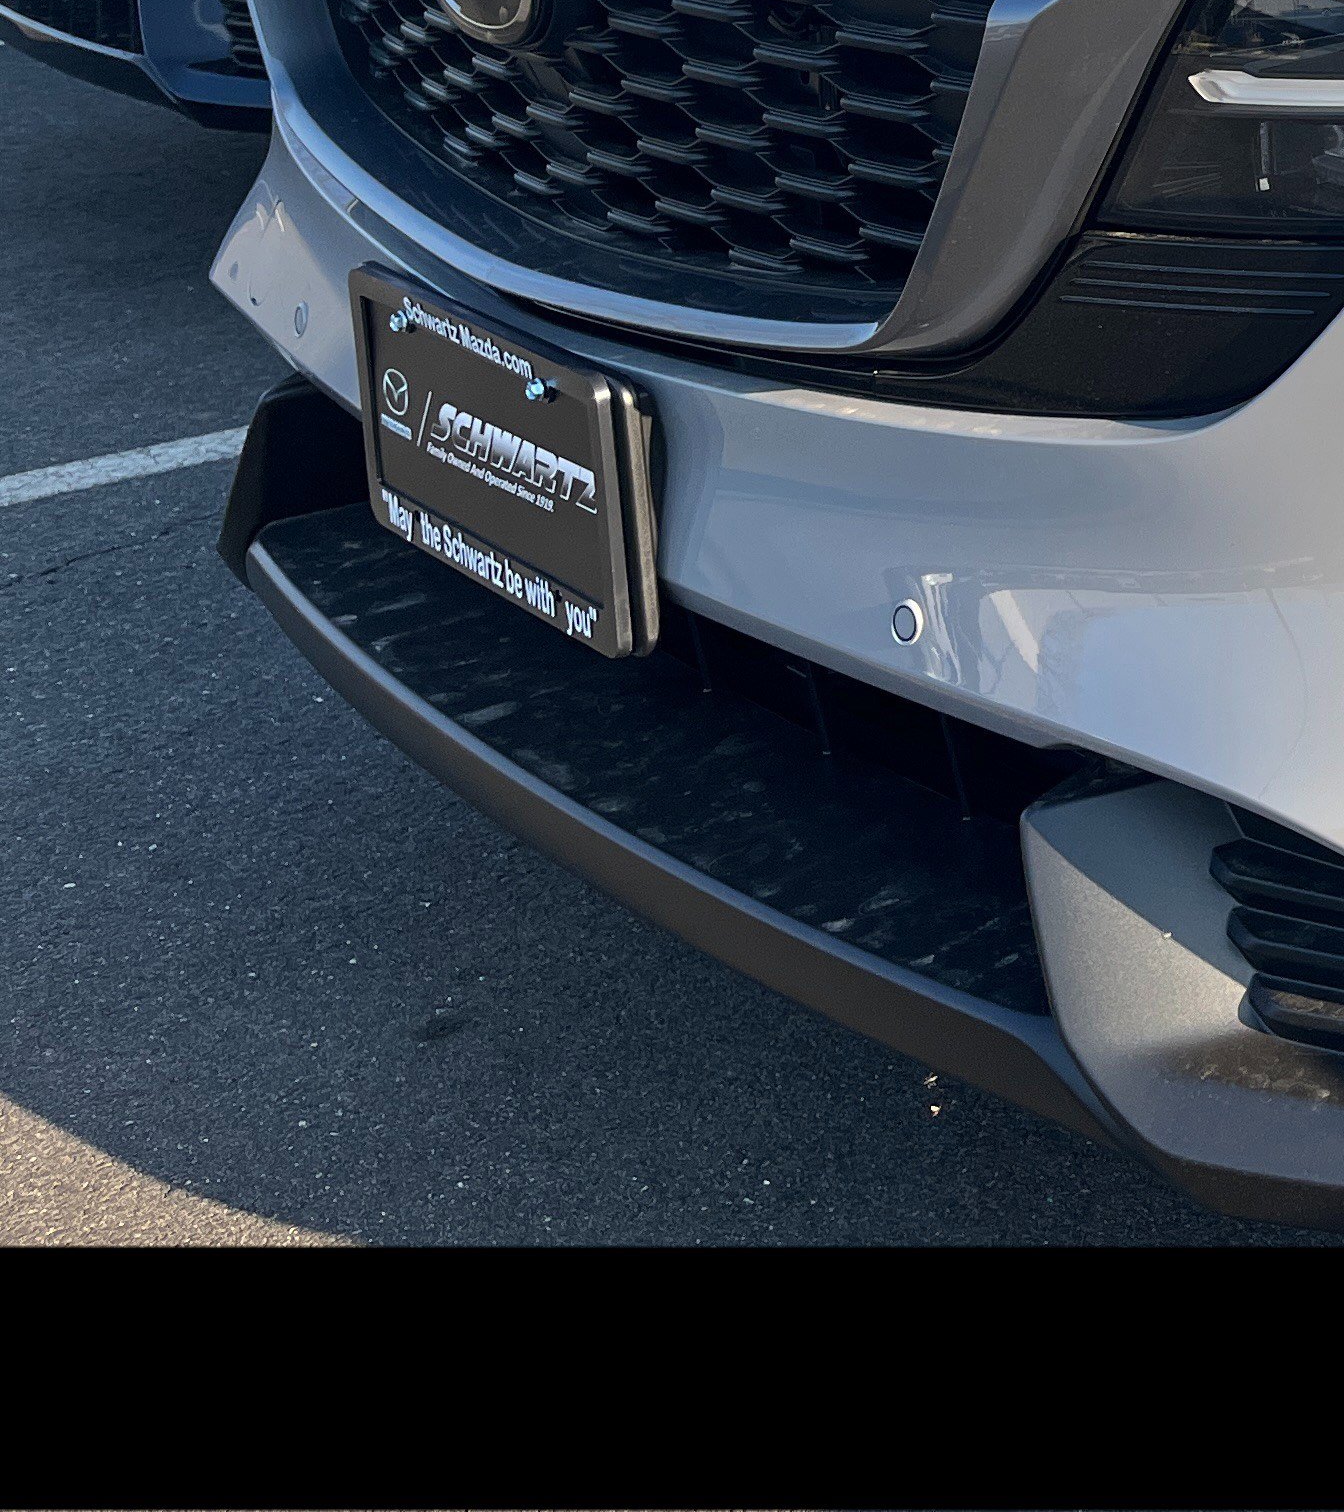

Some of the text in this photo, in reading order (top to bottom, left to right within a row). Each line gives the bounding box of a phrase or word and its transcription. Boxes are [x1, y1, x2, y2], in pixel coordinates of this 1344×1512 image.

[430, 403, 598, 515] SCHWARTZ
[420, 511, 442, 553] the
[442, 524, 504, 589] Schwartz
[504, 558, 523, 600] be
[524, 575, 556, 618] with
